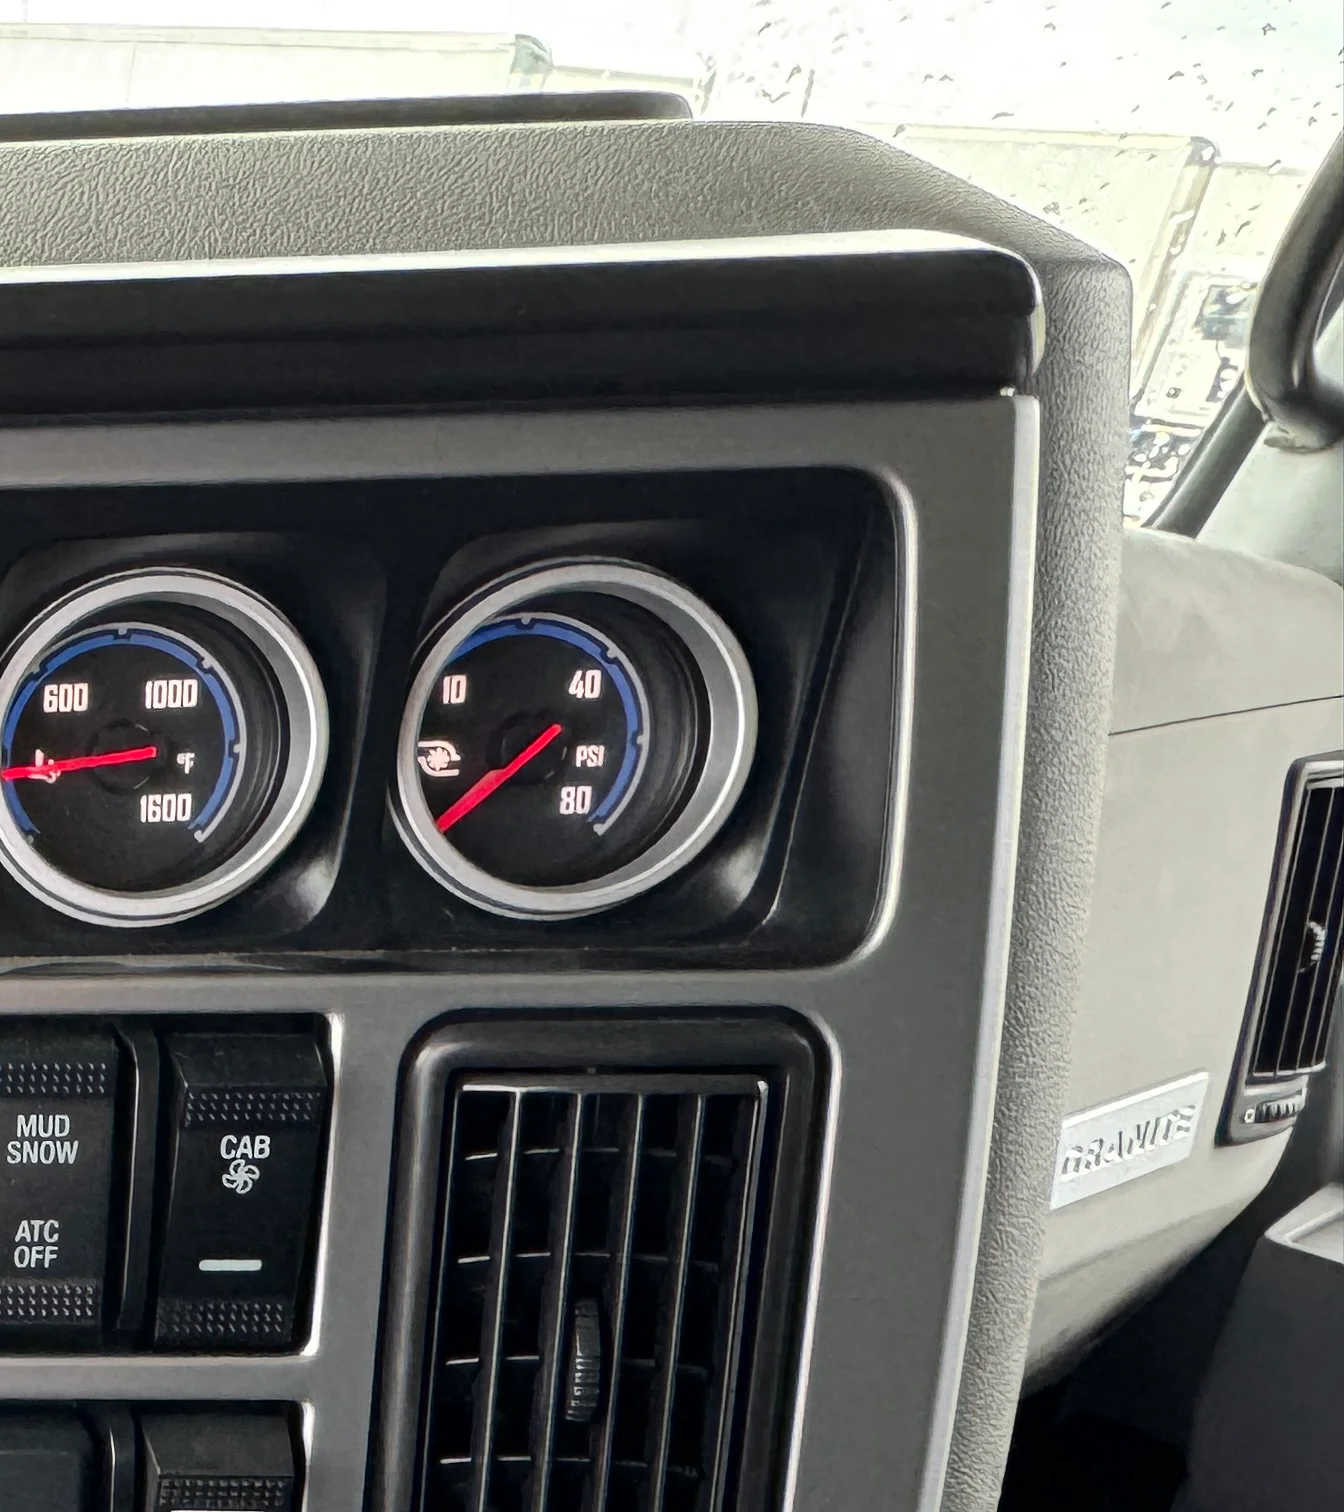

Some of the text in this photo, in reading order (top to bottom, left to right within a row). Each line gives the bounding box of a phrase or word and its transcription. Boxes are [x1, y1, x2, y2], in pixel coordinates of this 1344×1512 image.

[43, 679, 198, 713] 600 1000
[442, 669, 602, 704] 10 40
[575, 745, 605, 768] PSI
[140, 793, 192, 823] 1600
[559, 786, 592, 815] 80
[17, 1114, 70, 1138] MUD
[6, 1140, 78, 1165] SNOW
[221, 1135, 270, 1160] CAB
[14, 1218, 60, 1244] ATC
[13, 1245, 58, 1269] OFF
